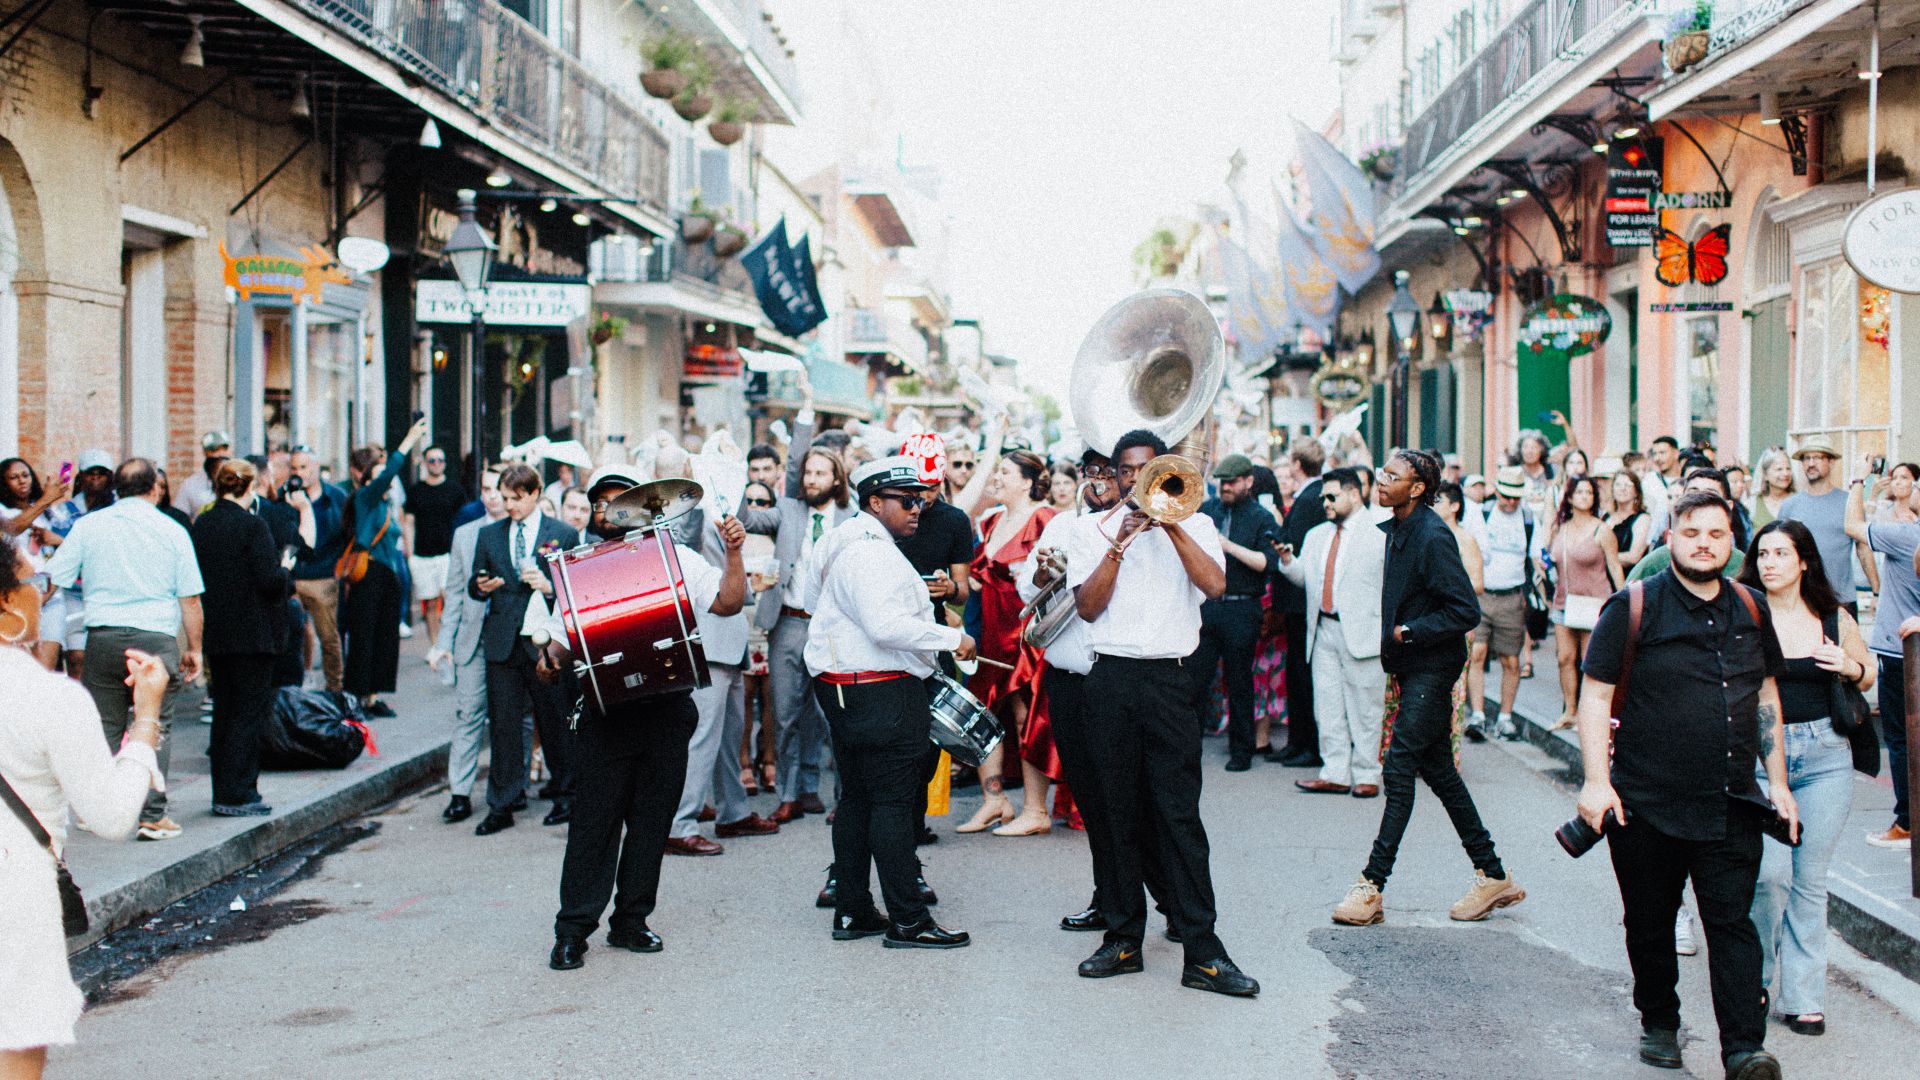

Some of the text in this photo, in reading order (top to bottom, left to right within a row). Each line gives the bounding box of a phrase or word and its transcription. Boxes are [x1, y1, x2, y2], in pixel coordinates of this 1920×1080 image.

[1654, 192, 1725, 209] ADORN
[1609, 214, 1629, 225] FOR
[235, 258, 304, 277] GALLERY
[427, 299, 577, 317] TWO SISTERS
